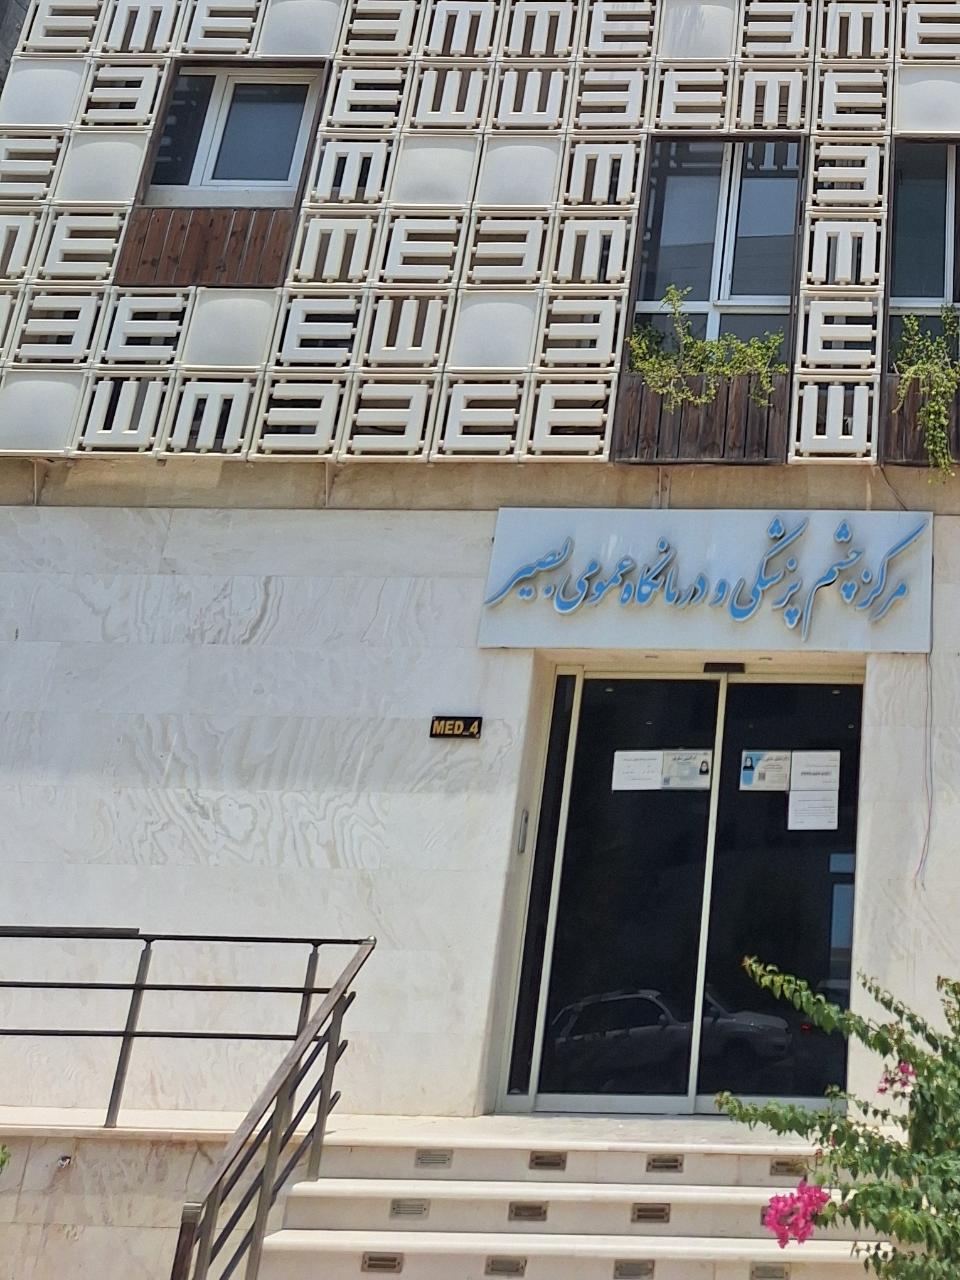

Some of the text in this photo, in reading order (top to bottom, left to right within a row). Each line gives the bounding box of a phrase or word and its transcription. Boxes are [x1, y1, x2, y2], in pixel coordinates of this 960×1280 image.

[484, 517, 929, 642] مرکز چشم پزشکی و درمانگاه عمومی بصیر
